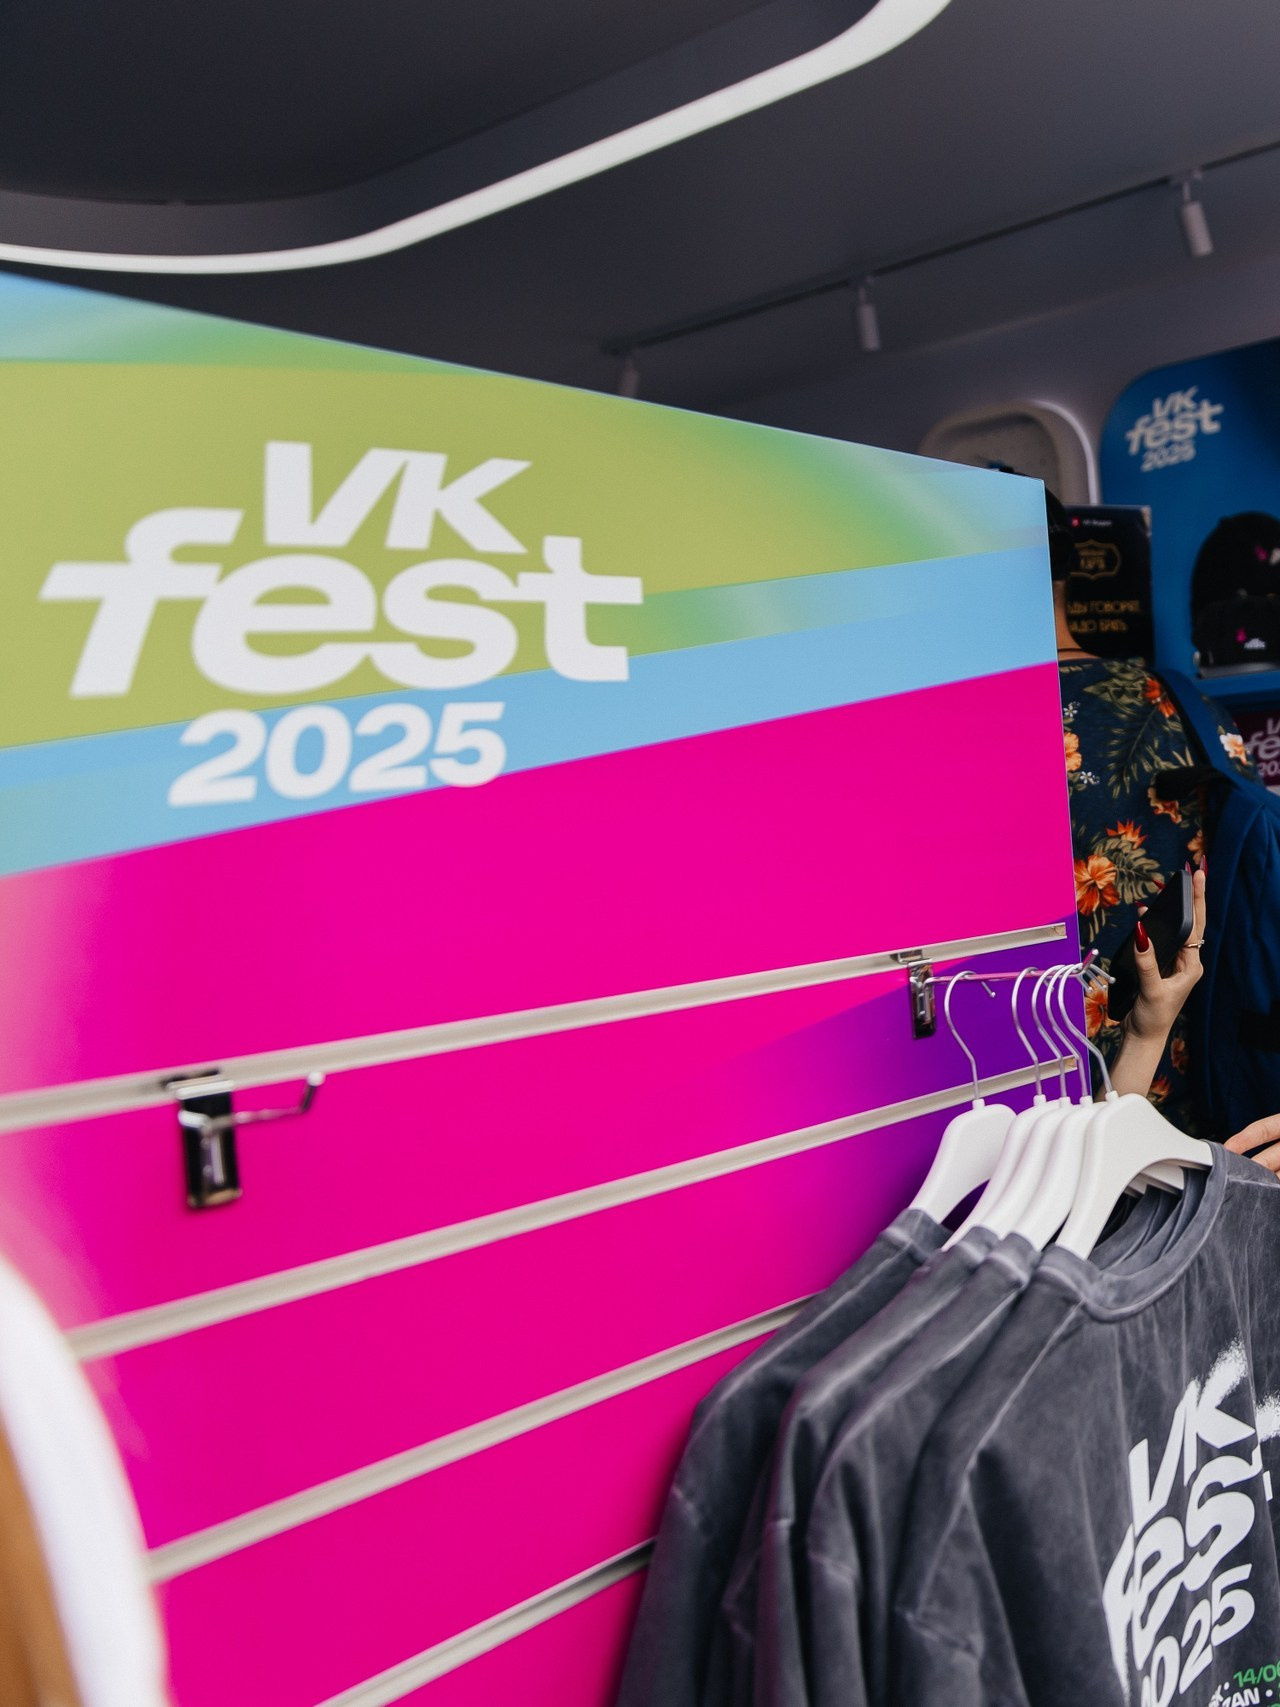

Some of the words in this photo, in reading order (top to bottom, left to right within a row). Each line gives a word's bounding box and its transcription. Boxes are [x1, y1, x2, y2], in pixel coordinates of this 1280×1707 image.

[1125, 399, 1224, 456] fest
[1152, 385, 1199, 420] VK
[263, 440, 533, 555] VK
[38, 506, 644, 698] fest
[167, 700, 506, 808] 2025
